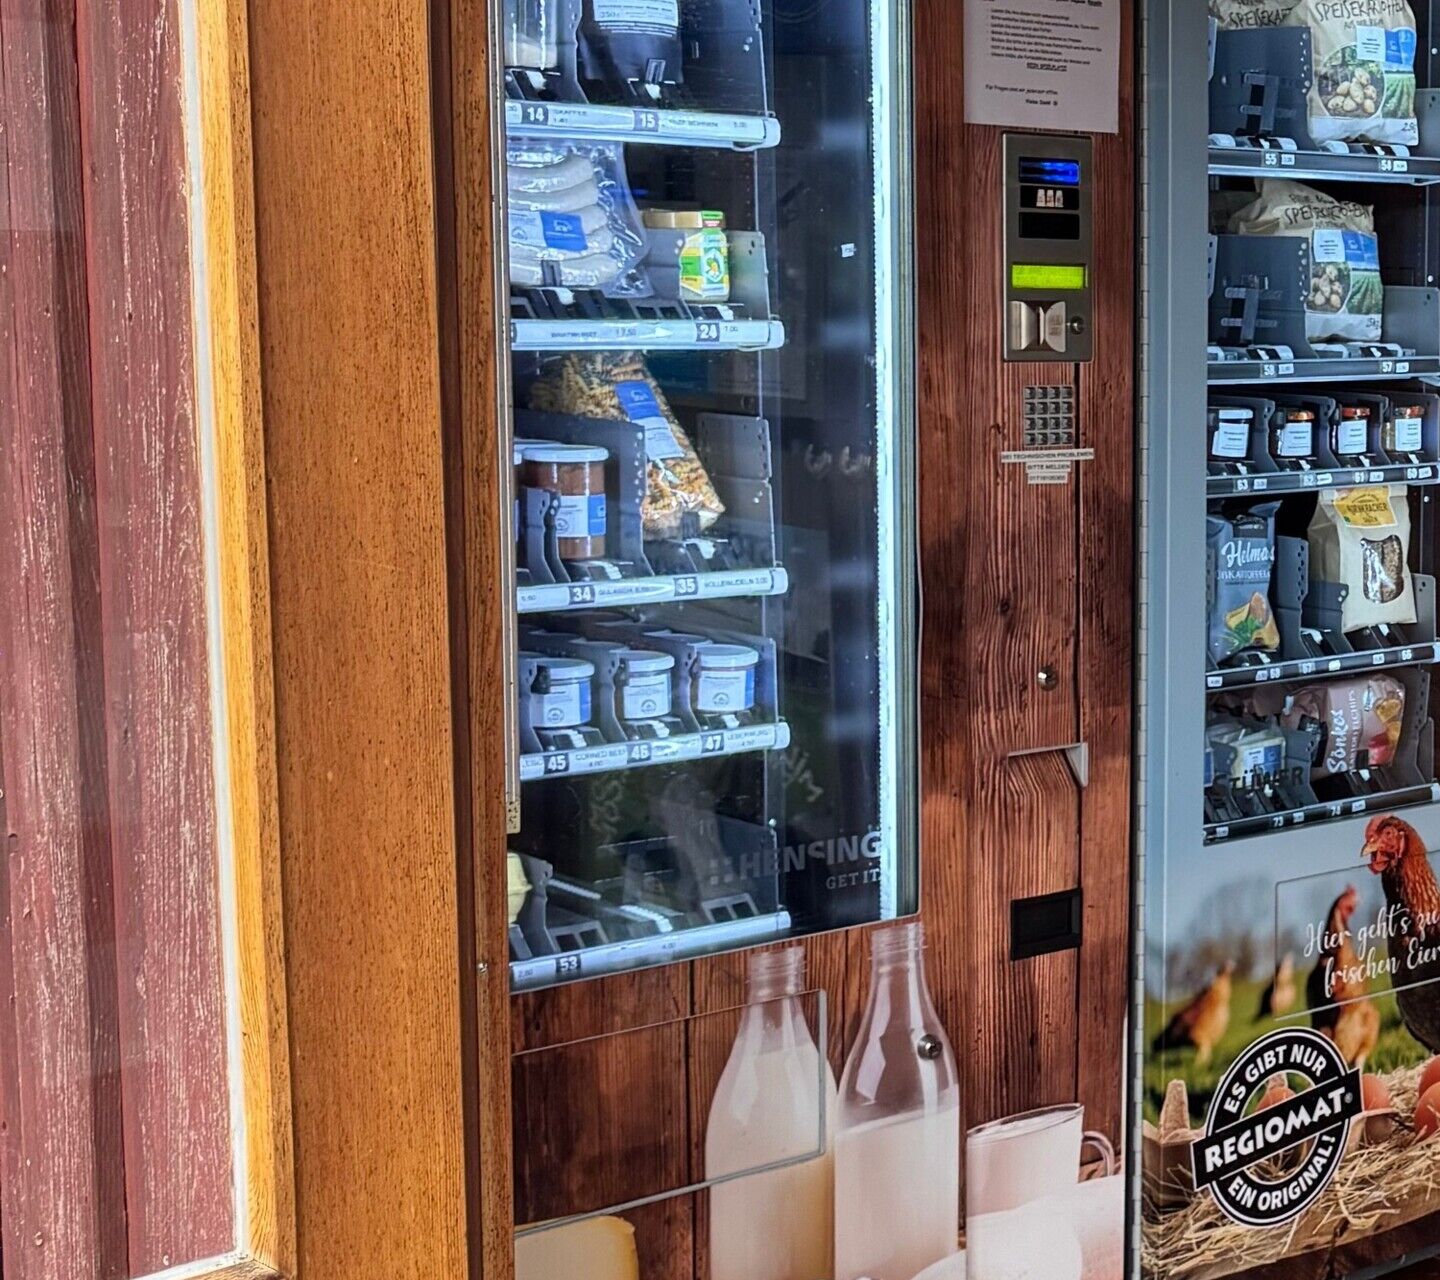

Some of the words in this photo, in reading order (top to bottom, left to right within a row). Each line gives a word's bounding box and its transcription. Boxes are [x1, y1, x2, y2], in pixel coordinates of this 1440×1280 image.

[527, 106, 545, 122] 14
[639, 112, 655, 128] 15
[700, 323, 718, 339] 24
[676, 578, 696, 593] 35
[573, 587, 592, 602] 34
[703, 735, 722, 751] 47
[631, 744, 649, 759] 46
[547, 755, 566, 770] 45
[826, 872, 859, 890] GET
[1304, 922, 1352, 957] Hier
[1357, 903, 1412, 961] geht's
[1418, 910, 1440, 941] zu
[559, 957, 578, 970] 53
[1324, 947, 1400, 998] frischen
[1223, 1081, 1247, 1114] ES
[1245, 1044, 1288, 1083] GIBT
[1289, 1043, 1327, 1077] NUR
[1227, 1175, 1257, 1209] EIN
[1257, 1134, 1336, 1211] ORIGINAL!
